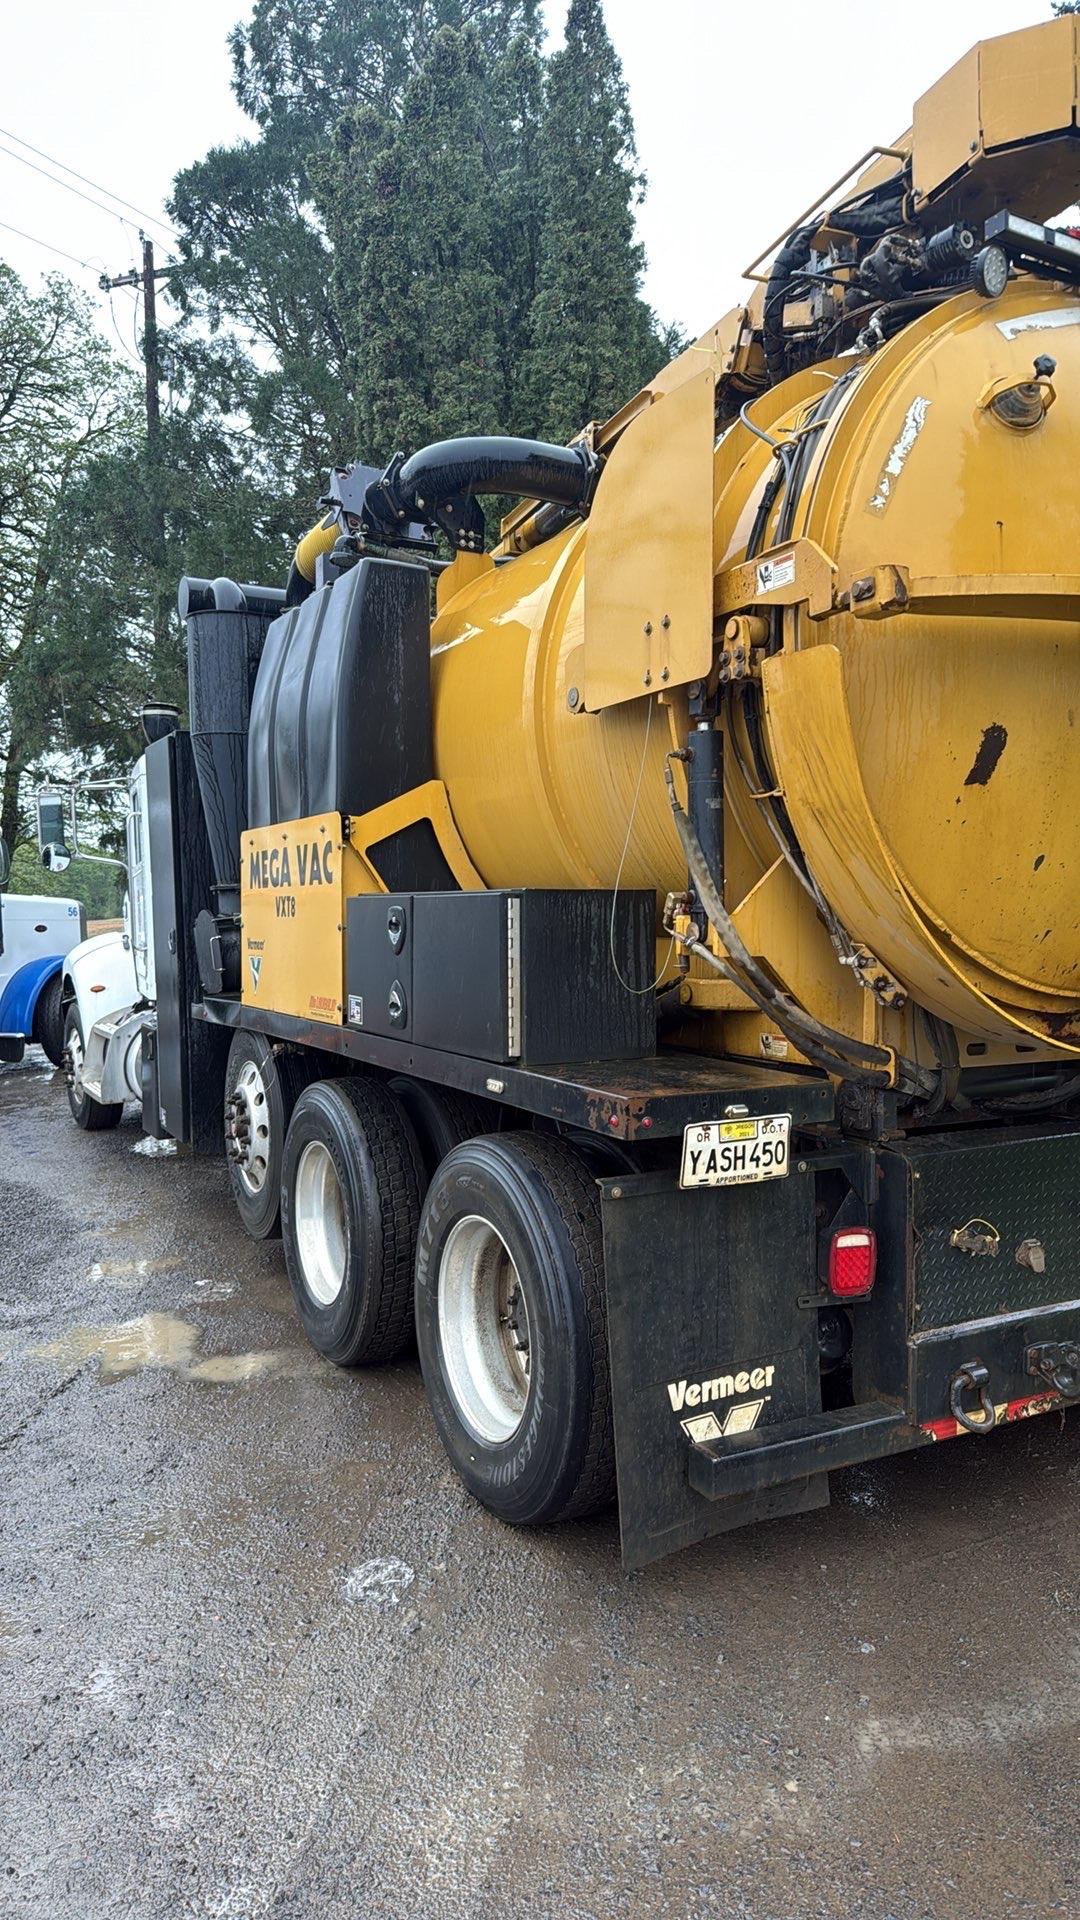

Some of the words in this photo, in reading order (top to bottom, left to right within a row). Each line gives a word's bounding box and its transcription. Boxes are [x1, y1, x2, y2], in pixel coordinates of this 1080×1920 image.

[250, 847, 291, 889] MEGA
[297, 841, 333, 886] VAC
[68, 907, 78, 917] 56
[275, 896, 296, 917] VXT8
[697, 1132, 710, 1142] OR
[762, 1124, 785, 1134] D.O.T.
[690, 1140, 785, 1175] YASH450
[716, 1173, 758, 1184] APPORTIONED
[667, 1366, 775, 1412] Vermeer
